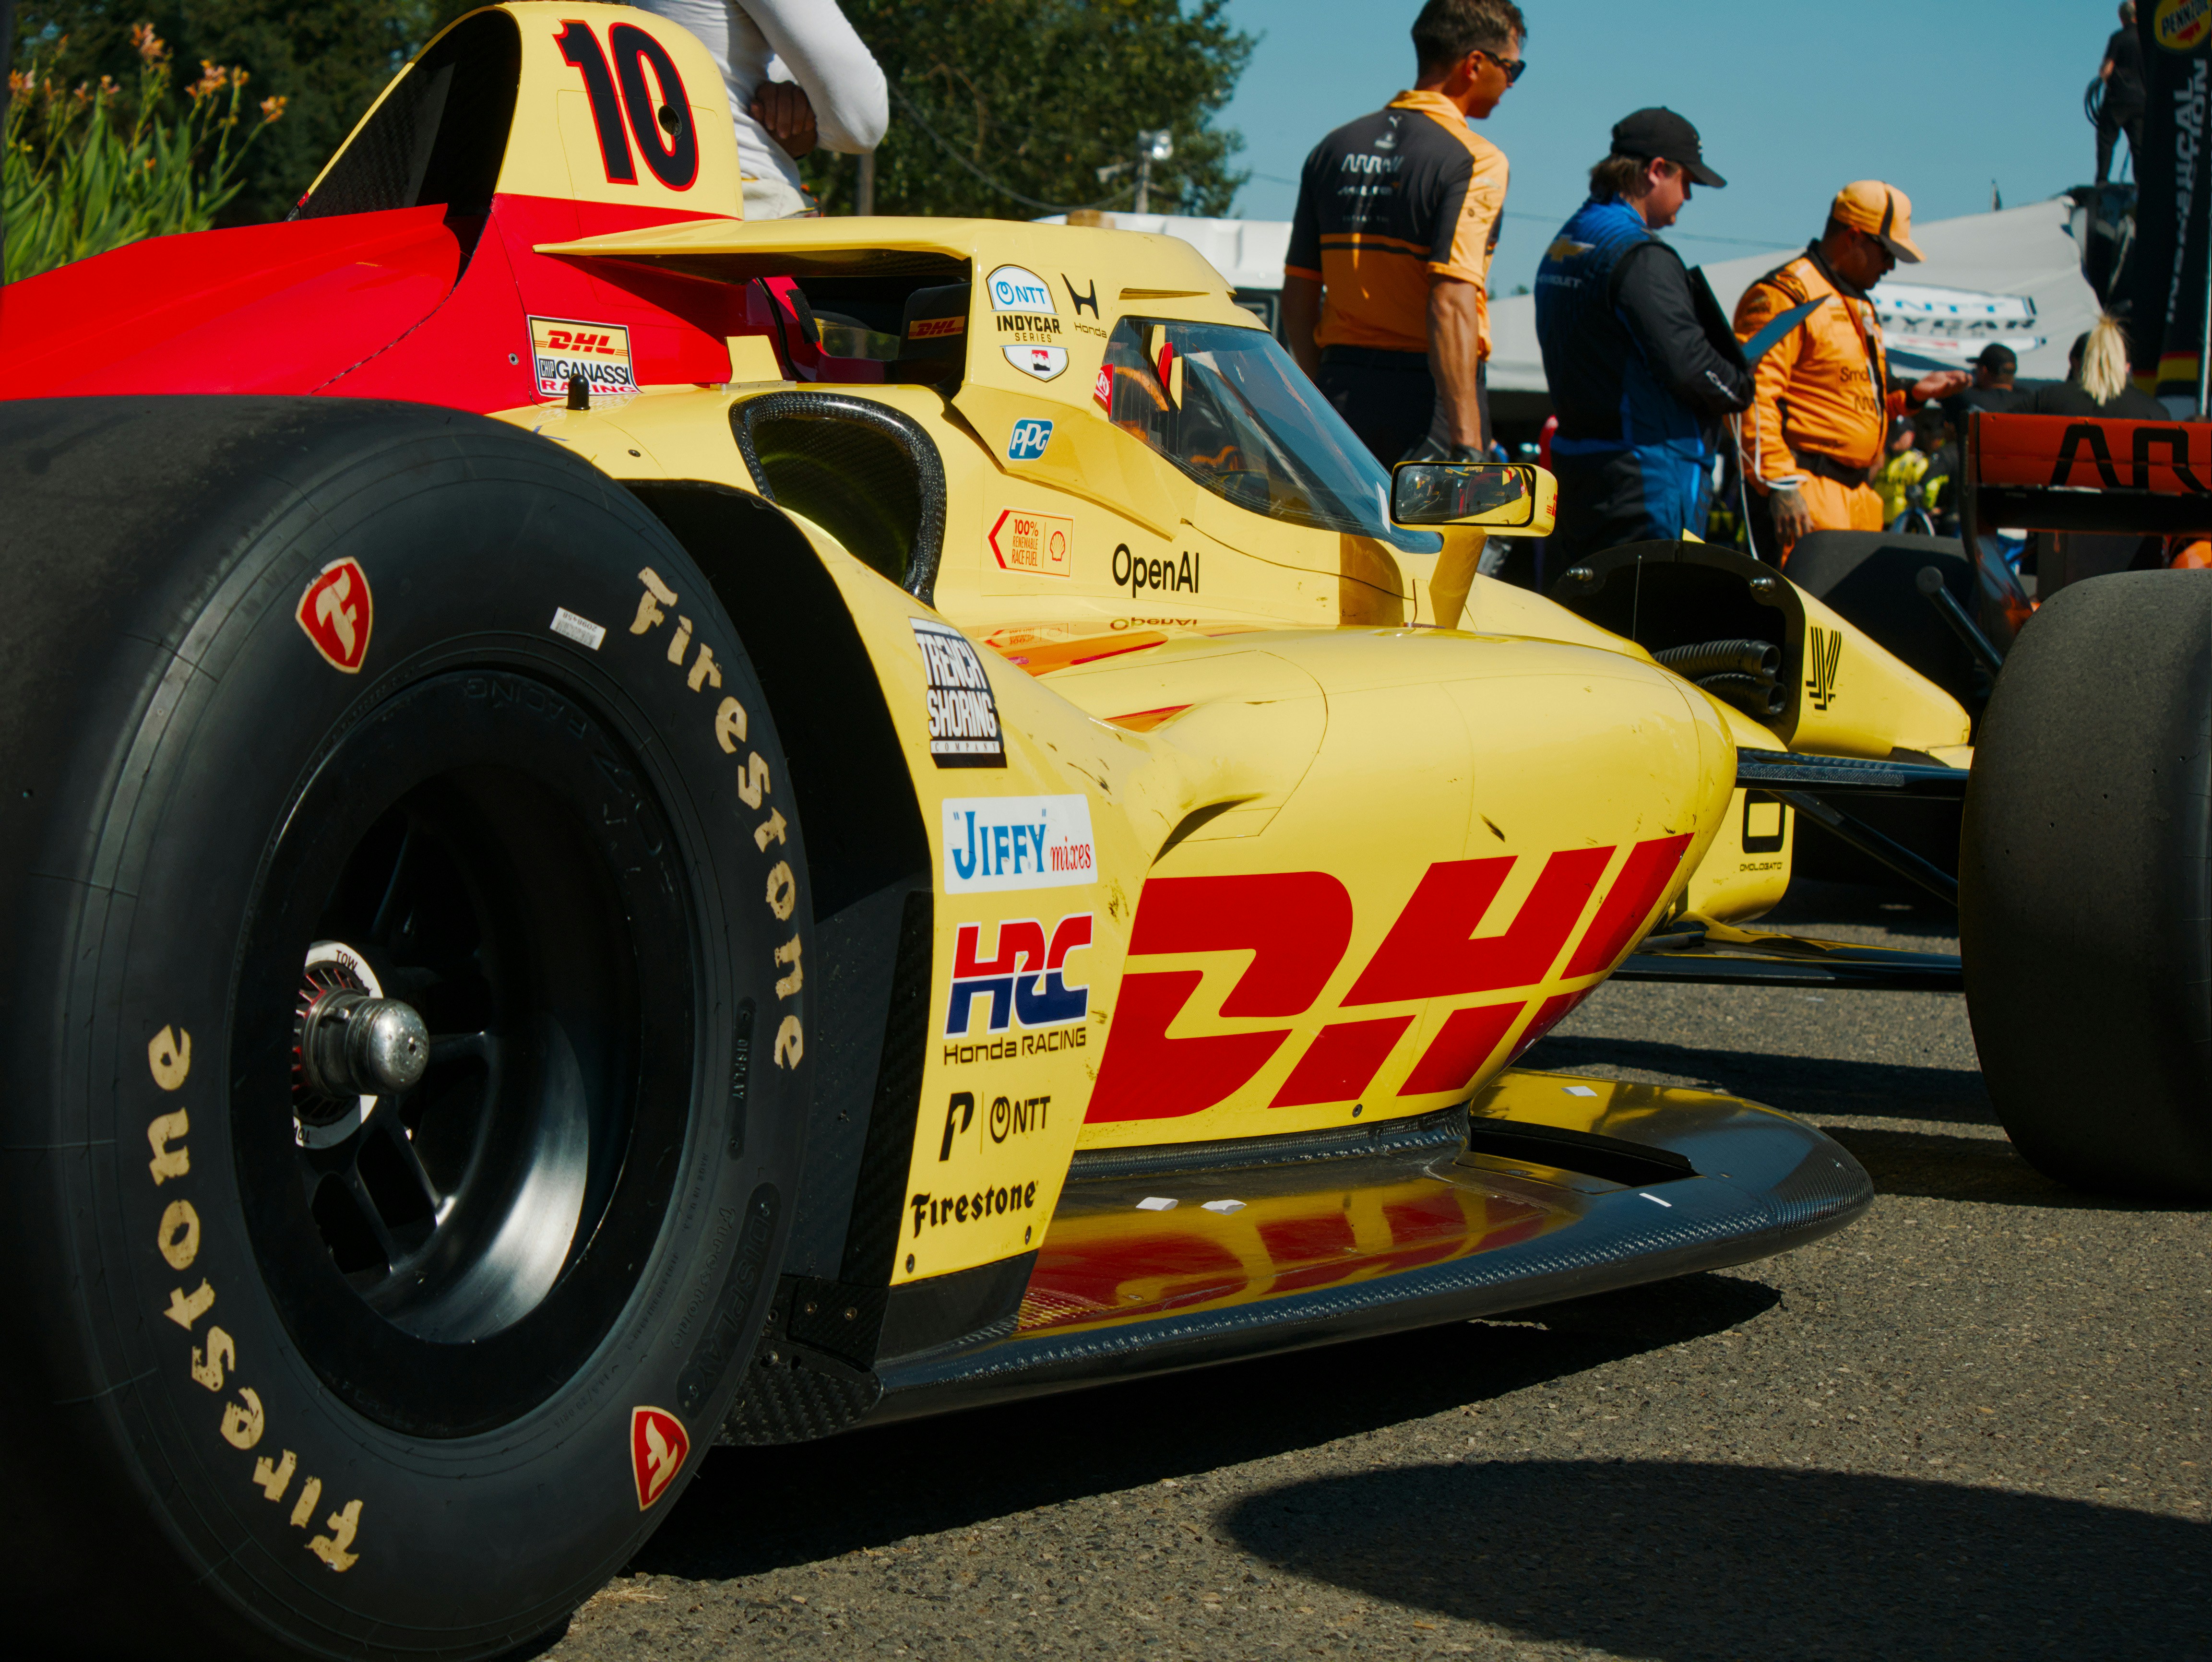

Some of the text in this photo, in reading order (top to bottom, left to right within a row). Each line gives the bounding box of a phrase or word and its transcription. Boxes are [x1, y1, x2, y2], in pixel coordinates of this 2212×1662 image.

[552, 19, 699, 192] 10
[1015, 285, 1045, 304] NTT
[916, 320, 956, 336] DHL
[997, 315, 1061, 334] INDYCAR
[1015, 332, 1052, 343] SERIES
[1074, 322, 1107, 339] Honda
[547, 330, 616, 355] DHL
[539, 359, 630, 385] CHIP GANASSI
[541, 380, 638, 393] RAING
[1011, 423, 1051, 456] PPG
[1012, 535, 1038, 550] RENEWABLE
[1014, 519, 1039, 537] 100%
[1011, 548, 1038, 567] RACE FUEL
[1112, 543, 1200, 598] OpenAI
[915, 633, 988, 690] TRENCH
[927, 689, 998, 738] SHORING
[935, 741, 998, 753] COMPANY
[629, 567, 804, 1070] Firestone
[1050, 836, 1091, 871] mixes
[335, 949, 358, 972] TOW
[943, 911, 1094, 1039] HRC
[944, 1027, 1086, 1065] Honda RACING
[732, 1037, 749, 1100] DISPLAY
[1013, 1096, 1051, 1134] NTT
[910, 1180, 1035, 1238] Firestone
[147, 1024, 363, 1572] Firestone
